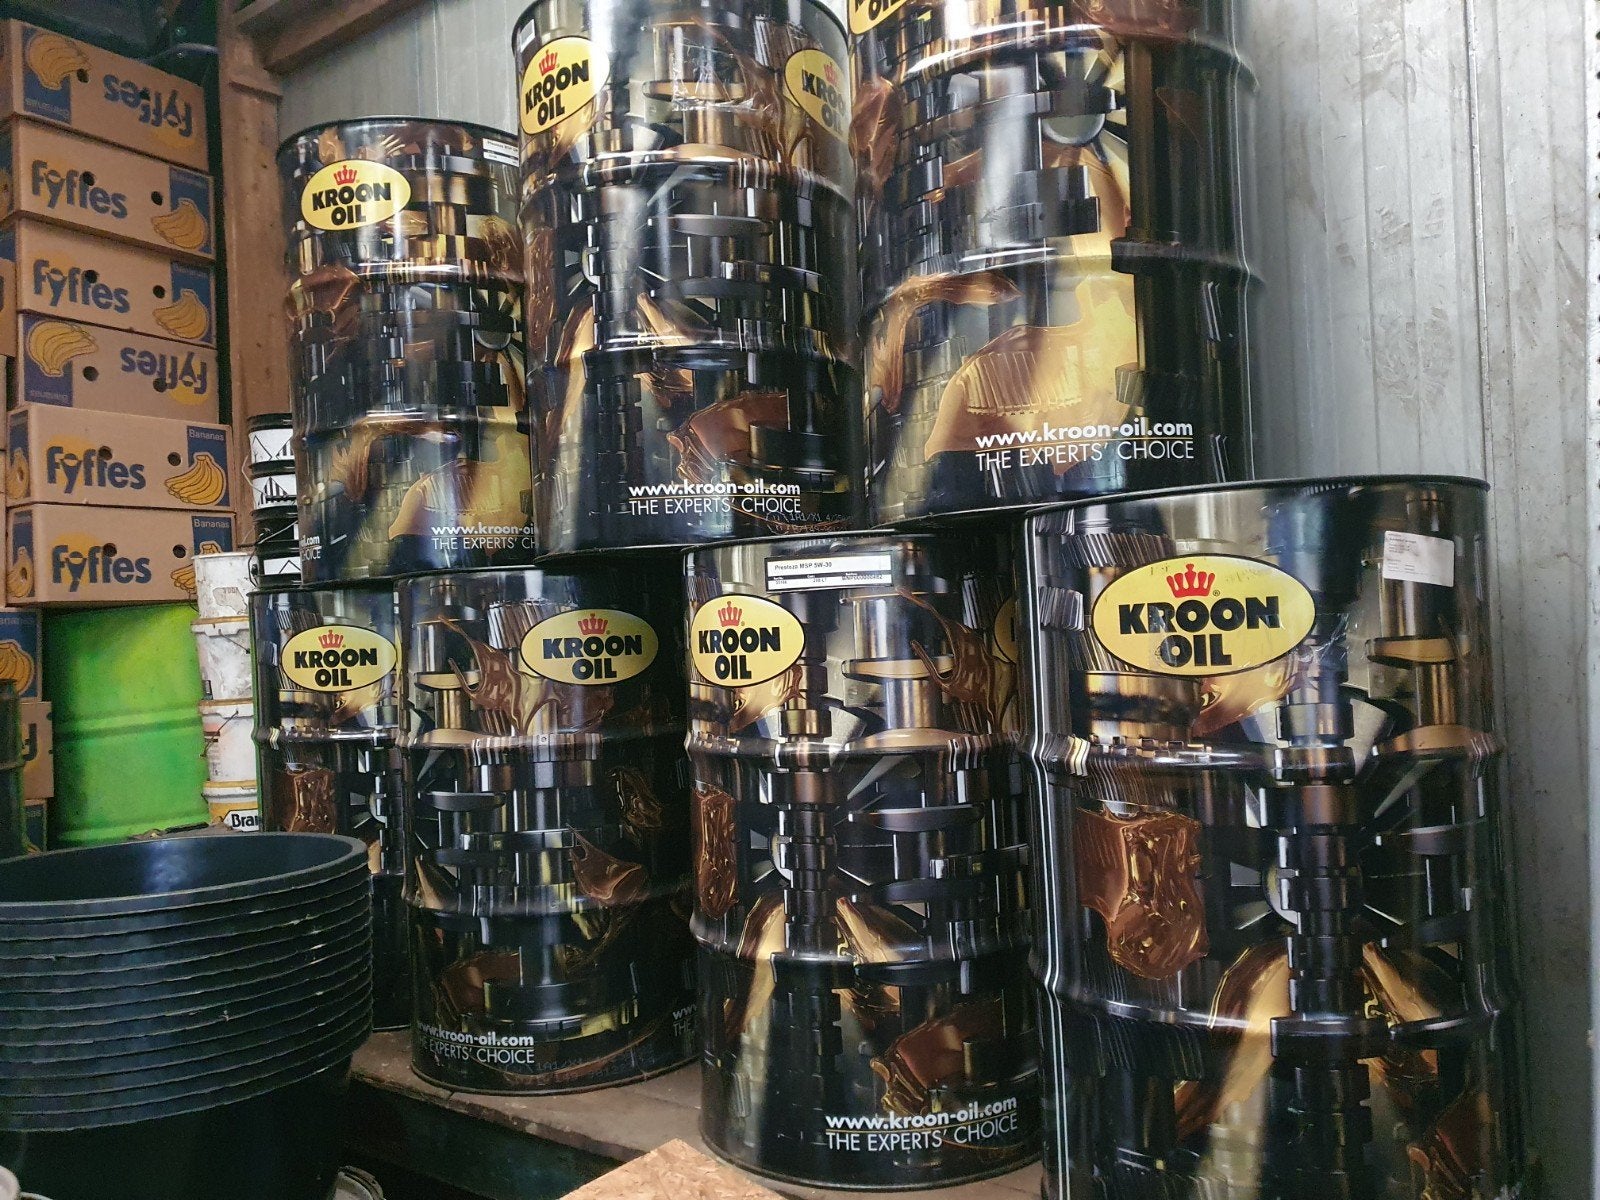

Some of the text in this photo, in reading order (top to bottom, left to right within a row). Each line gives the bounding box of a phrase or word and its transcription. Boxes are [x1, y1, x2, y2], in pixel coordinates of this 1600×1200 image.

[525, 60, 590, 115] KROON
[802, 69, 847, 117] KROO
[537, 95, 566, 127] OIL
[31, 160, 128, 219] fyffes
[312, 182, 392, 212] KROON
[330, 206, 367, 226] OIL
[33, 259, 130, 313] fyffes
[119, 347, 208, 395] fyffes
[188, 428, 224, 442] Bananas
[976, 416, 1193, 449] www.kroon-oil.com
[46, 445, 147, 494] fyffes
[976, 439, 1195, 471] THE EXPERTS' CHOICE
[628, 478, 801, 497] www.kroon-oil.com
[629, 497, 801, 516] THE EXPERTS' CHOICE
[194, 518, 230, 530] Bananas
[432, 537, 458, 550] THE
[52, 544, 152, 593] fyffes
[1118, 596, 1281, 635] KROON
[542, 635, 643, 660] KROON
[698, 626, 781, 654] KROON
[1160, 633, 1233, 668] OIL
[294, 648, 378, 669] KROON
[572, 658, 618, 681] OIL
[714, 655, 752, 680] OIL
[314, 668, 353, 688] OIL
[476, 1048, 535, 1064] CHOICE
[825, 1096, 1018, 1131] www.kroon-oil.com
[826, 1111, 1018, 1152] THE EXPERTS' CHOICE
